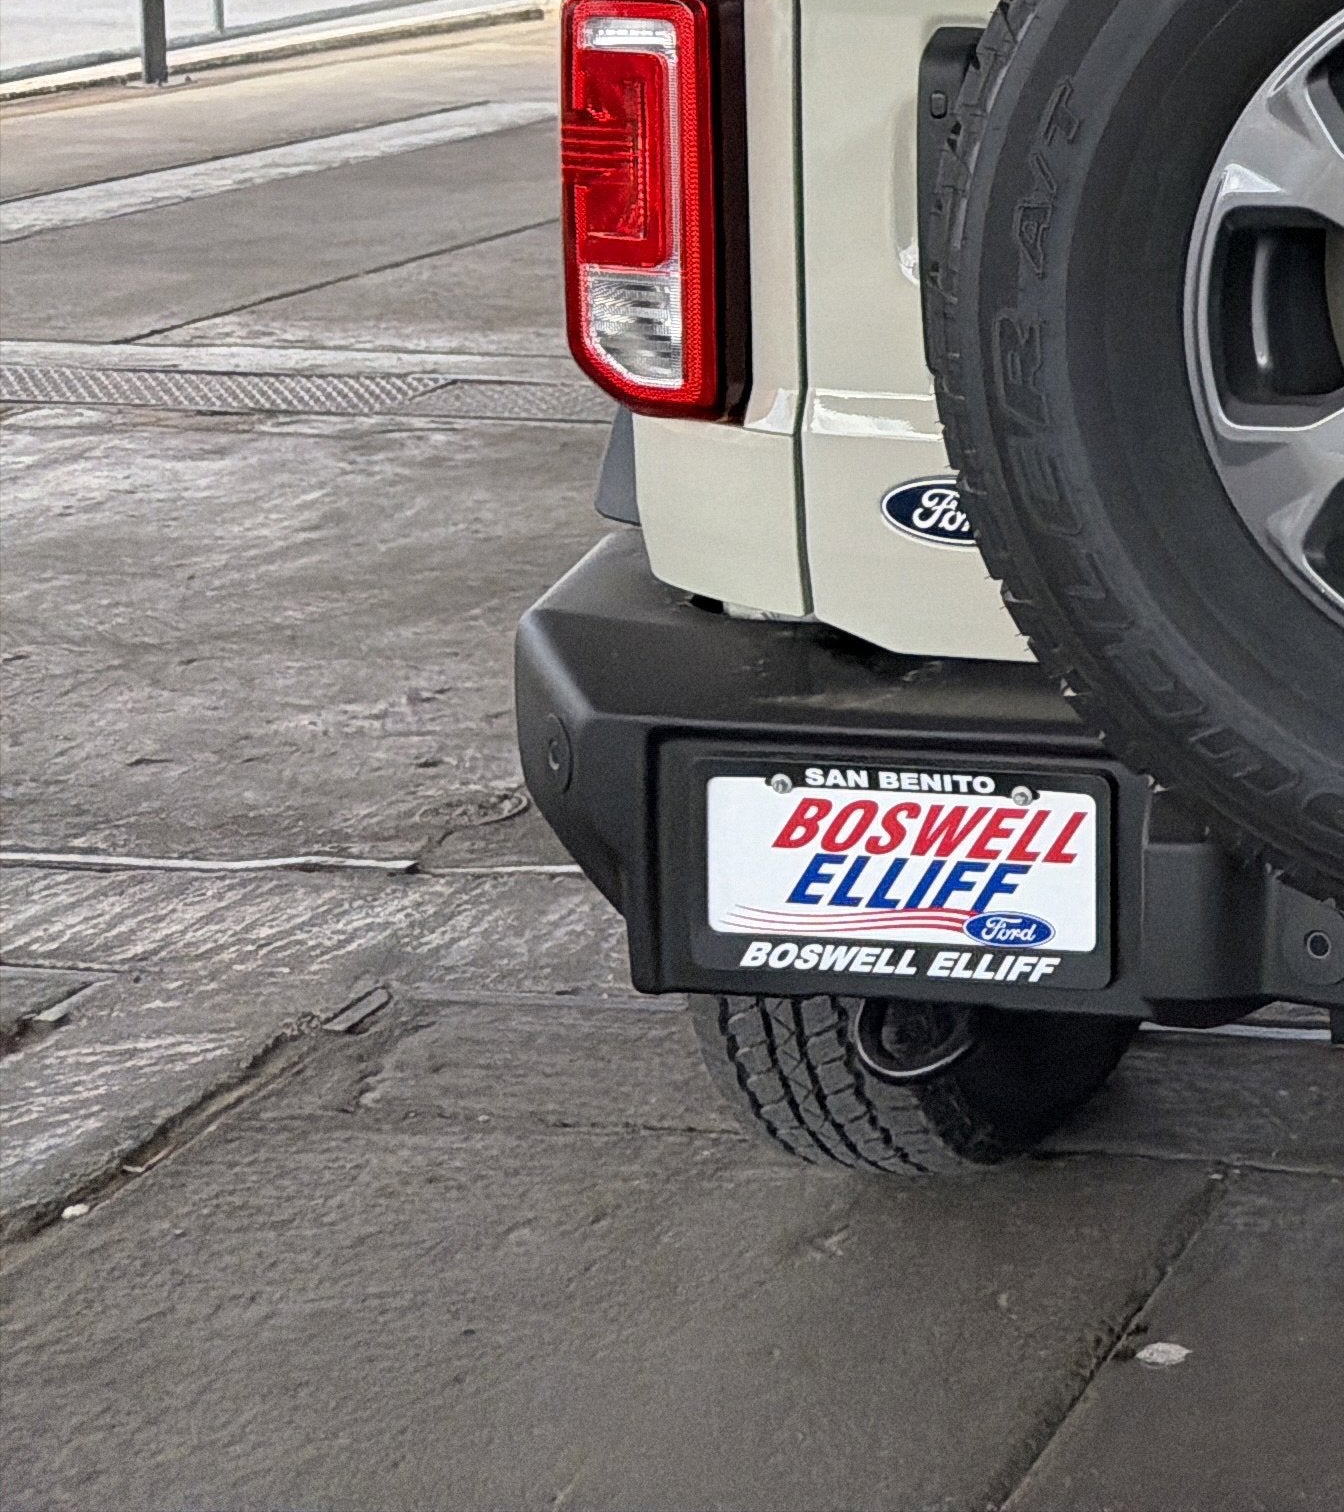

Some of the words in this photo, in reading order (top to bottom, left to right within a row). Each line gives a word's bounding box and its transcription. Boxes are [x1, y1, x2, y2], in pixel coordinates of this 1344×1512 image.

[804, 767, 870, 790] SAN
[877, 770, 996, 795] BENITO
[771, 796, 1089, 864] BOSWELL
[785, 852, 1033, 914] ELLIFF
[980, 915, 1038, 943] Ford
[739, 941, 918, 976] BOSWELL
[926, 951, 1062, 984] ELLIFF
